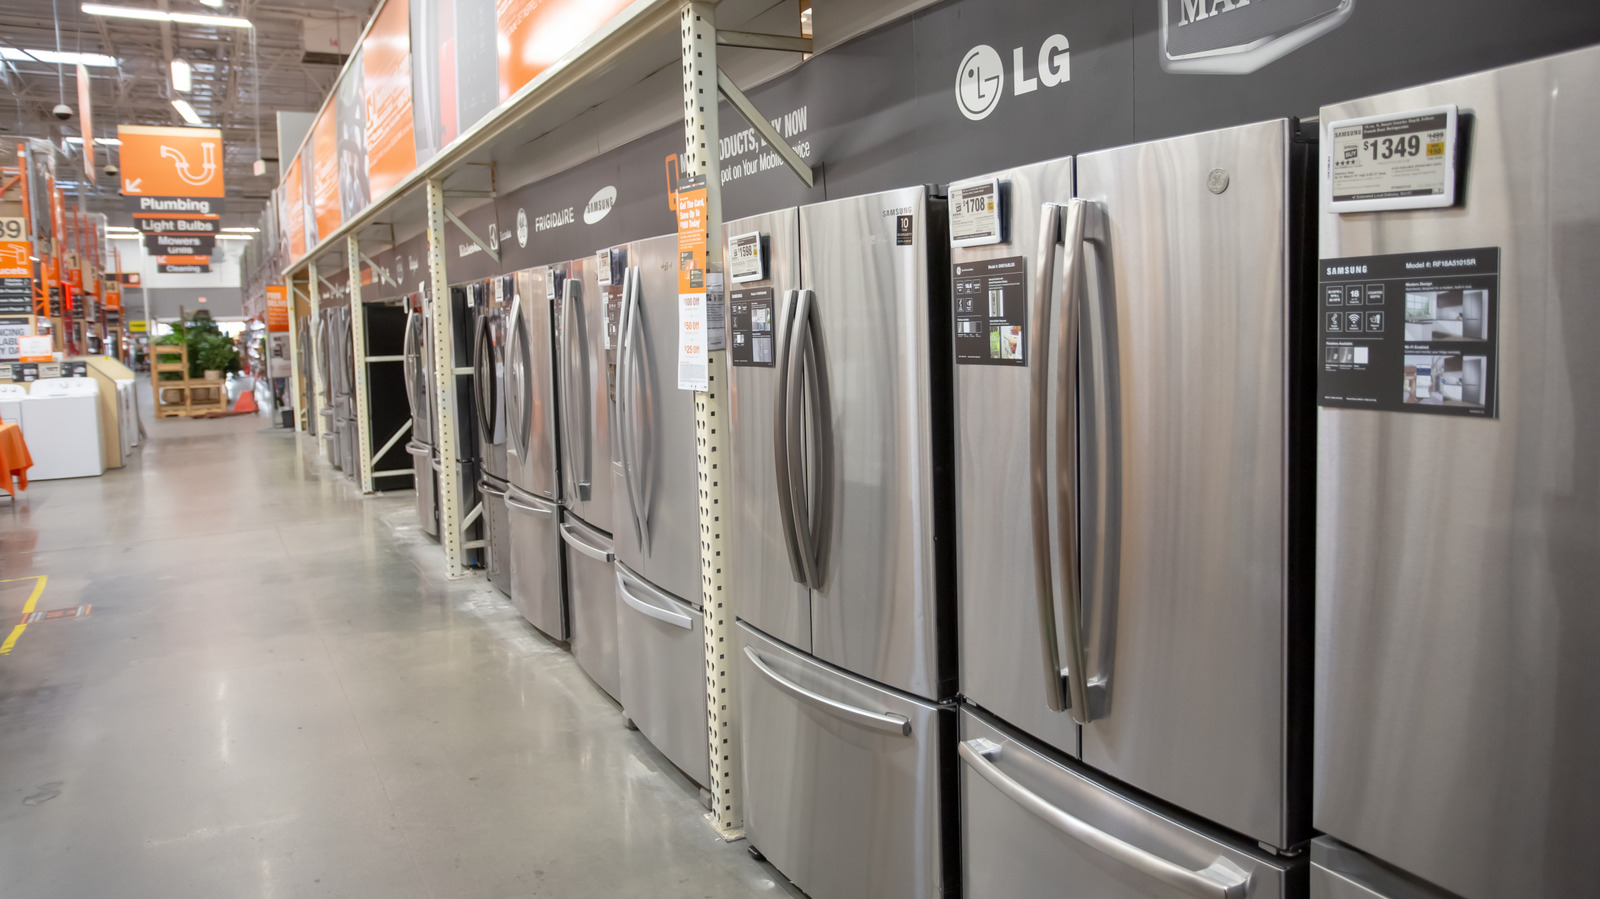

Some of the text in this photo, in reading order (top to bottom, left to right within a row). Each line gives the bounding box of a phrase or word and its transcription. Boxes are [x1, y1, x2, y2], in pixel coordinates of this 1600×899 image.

[1013, 33, 1071, 97] LG
[719, 127, 759, 161] ODUCTS,
[784, 105, 807, 139] NOW
[1335, 129, 1361, 137] SAMSUNG
[1363, 134, 1420, 160] $1349
[721, 164, 732, 187] pot
[733, 165, 742, 180] on
[742, 159, 758, 176] Your
[792, 140, 810, 158] vice
[140, 197, 210, 213] Plumbing
[587, 196, 614, 214] SAMSUNG
[882, 206, 912, 217] SAMSUNG
[963, 197, 985, 213] $1708
[142, 219, 213, 233] Light Bulbs
[535, 207, 574, 232] FRIGIDAIRE
[900, 217, 909, 229] 10
[158, 235, 201, 246] Mowers
[1326, 264, 1368, 275] SAMSUNG
[0, 328, 24, 337] NCING
